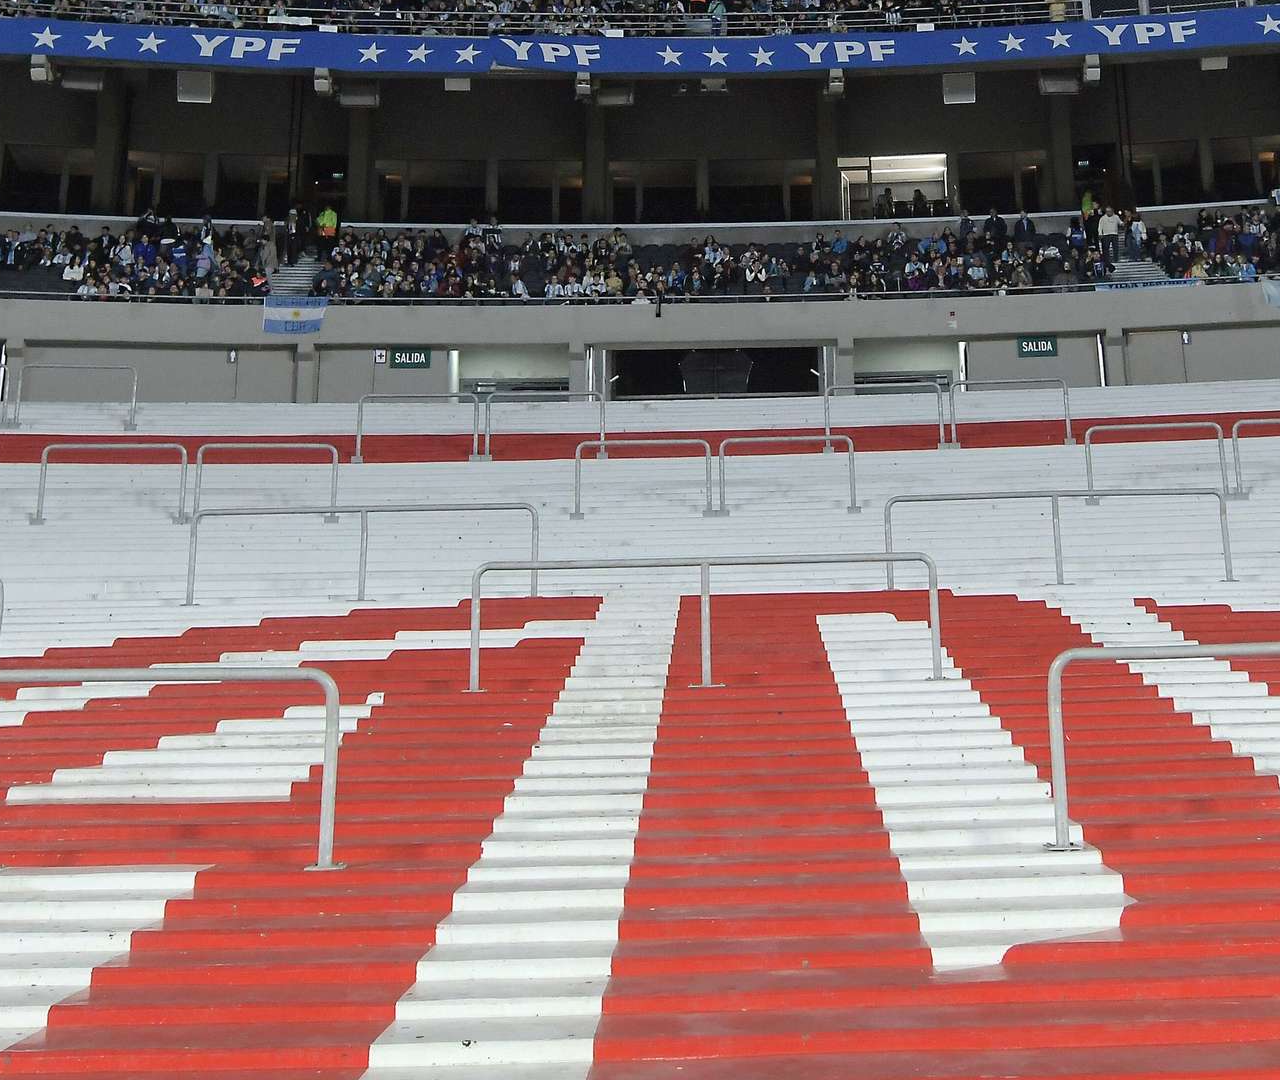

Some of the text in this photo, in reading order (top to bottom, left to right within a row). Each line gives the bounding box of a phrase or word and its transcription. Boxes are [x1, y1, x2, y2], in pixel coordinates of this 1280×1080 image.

[1093, 19, 1197, 46] YPF
[191, 34, 301, 61] YPF
[499, 38, 601, 66] YPF
[794, 41, 895, 63] YPF
[394, 352, 426, 363] SALIDA
[1022, 340, 1053, 352] SALIDA
